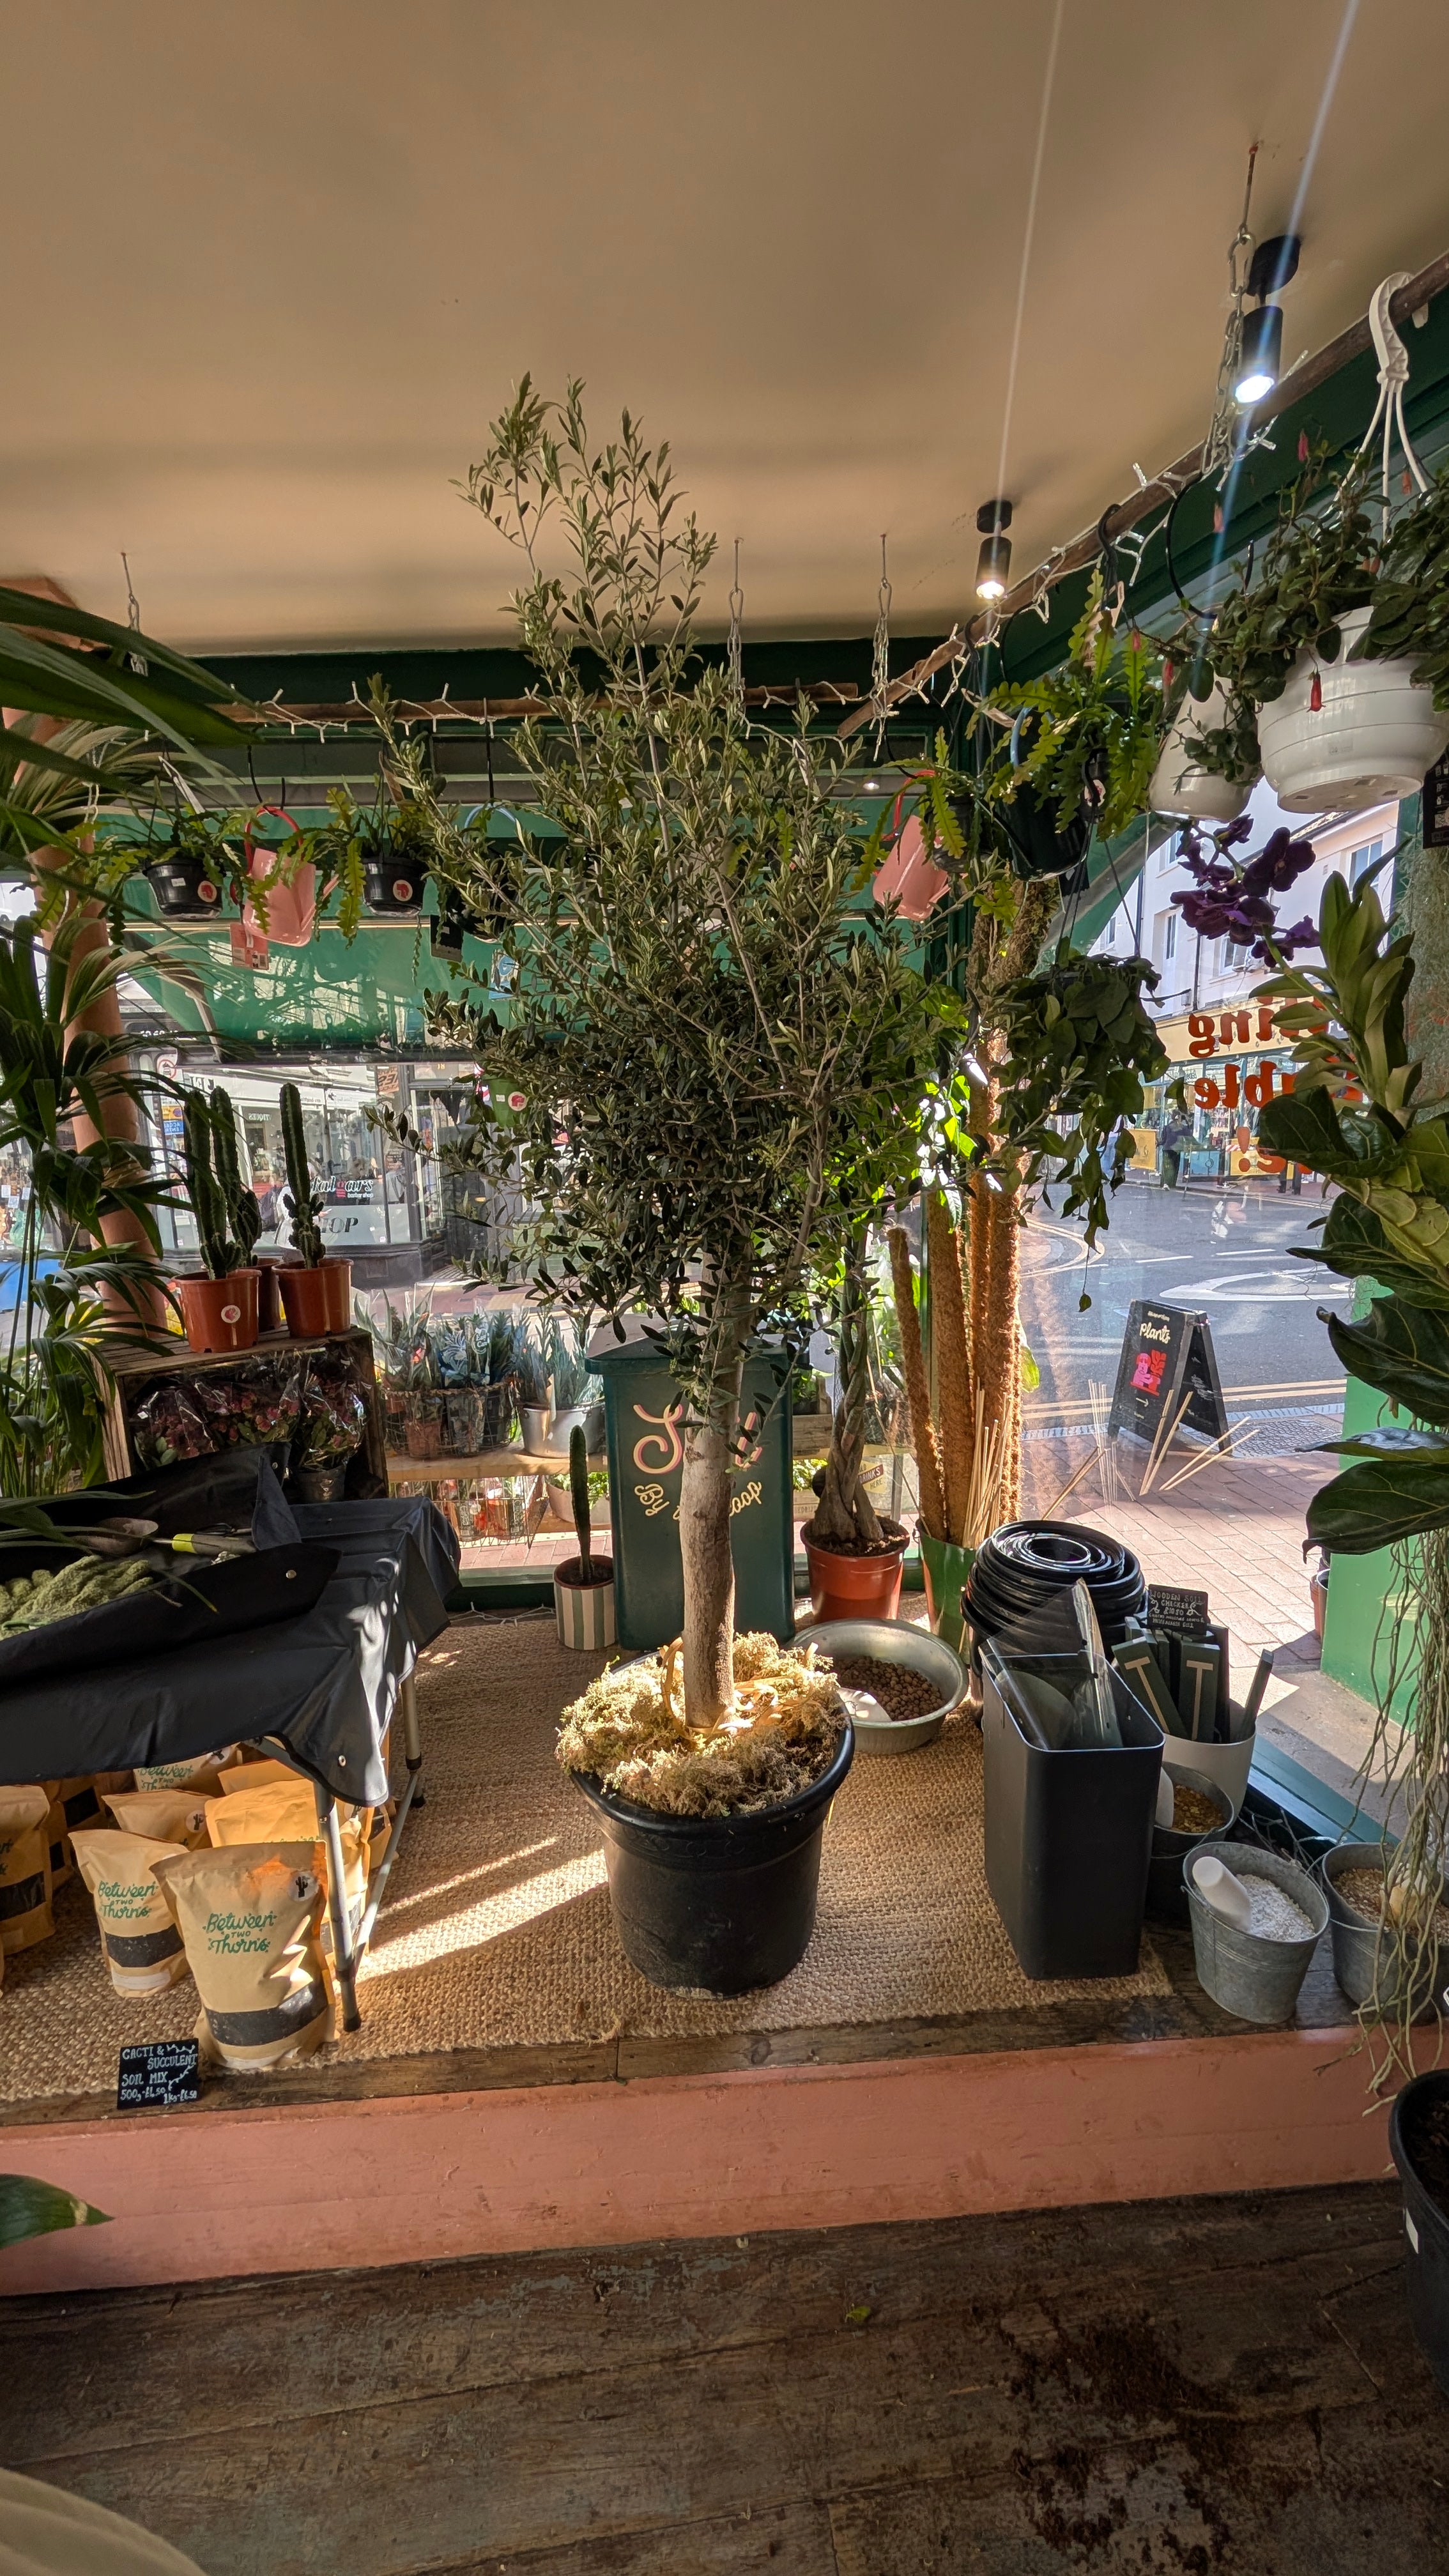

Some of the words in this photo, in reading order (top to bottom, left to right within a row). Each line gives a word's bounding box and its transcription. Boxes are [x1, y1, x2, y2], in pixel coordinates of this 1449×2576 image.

[1139, 1321, 1171, 1344] Plants
[859, 1466, 881, 1483] DRINKS
[870, 1478, 883, 1490] HERE
[634, 1483, 670, 1517] By
[1149, 1589, 1180, 1601] WOODEN
[98, 1881, 157, 1897] Between
[101, 1900, 151, 1919] Thorns
[205, 1912, 275, 1933] Between
[209, 1933, 270, 1954] Thorns
[122, 2046, 154, 2060] CACTI
[157, 2045, 164, 2056] &
[147, 2053, 197, 2070] SUCCULENT
[121, 2073, 144, 2087] SOIL
[150, 2071, 168, 2084] MIX
